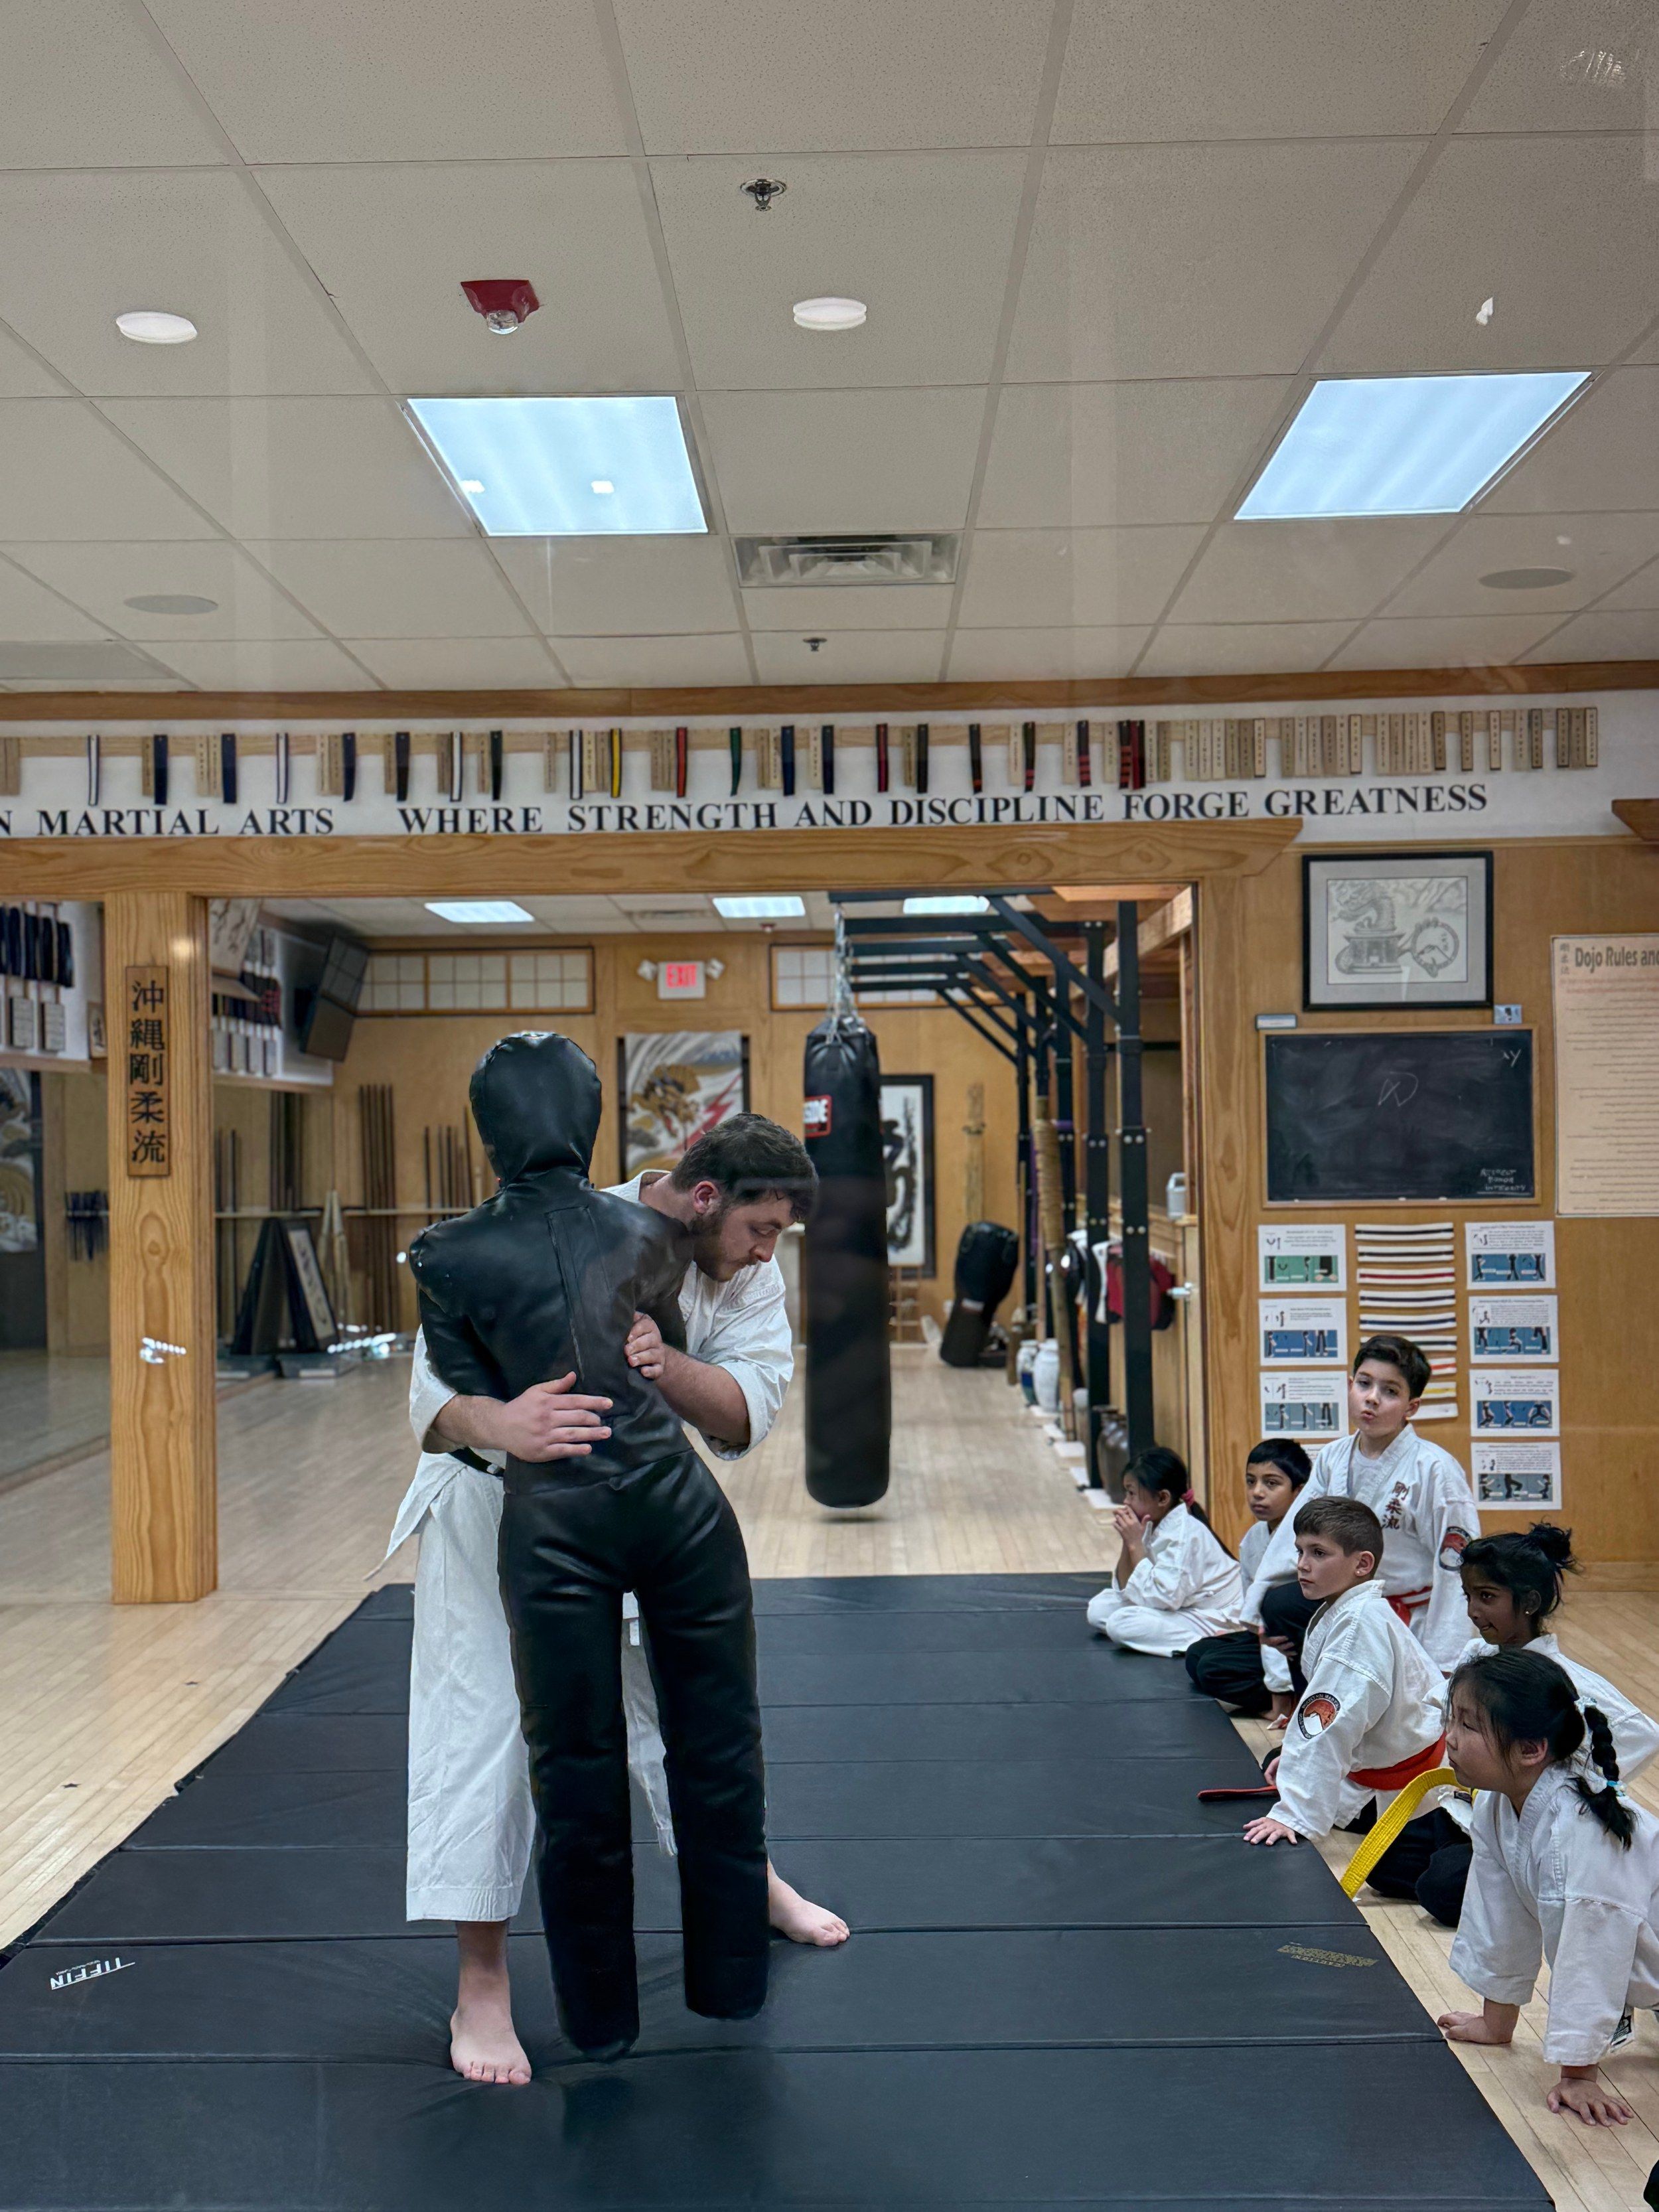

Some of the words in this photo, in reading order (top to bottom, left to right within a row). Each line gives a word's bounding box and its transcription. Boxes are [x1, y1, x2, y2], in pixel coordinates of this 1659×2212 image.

[37, 809, 220, 836] MARTIAL
[240, 808, 334, 835] ARTS
[399, 806, 543, 834] WHERE
[568, 802, 777, 832] STRENGTH
[795, 800, 873, 828] AND
[889, 793, 1105, 826] DISCIPLINE
[1123, 790, 1250, 821] FORGE
[1264, 783, 1488, 816] GREATNESS
[666, 964, 697, 988] EXIT
[1575, 946, 1603, 974] Dojo
[1606, 946, 1638, 967] Rules
[129, 980, 167, 1164] 沖縄剛柔流
[50, 1956, 136, 1990] TIFFIN
